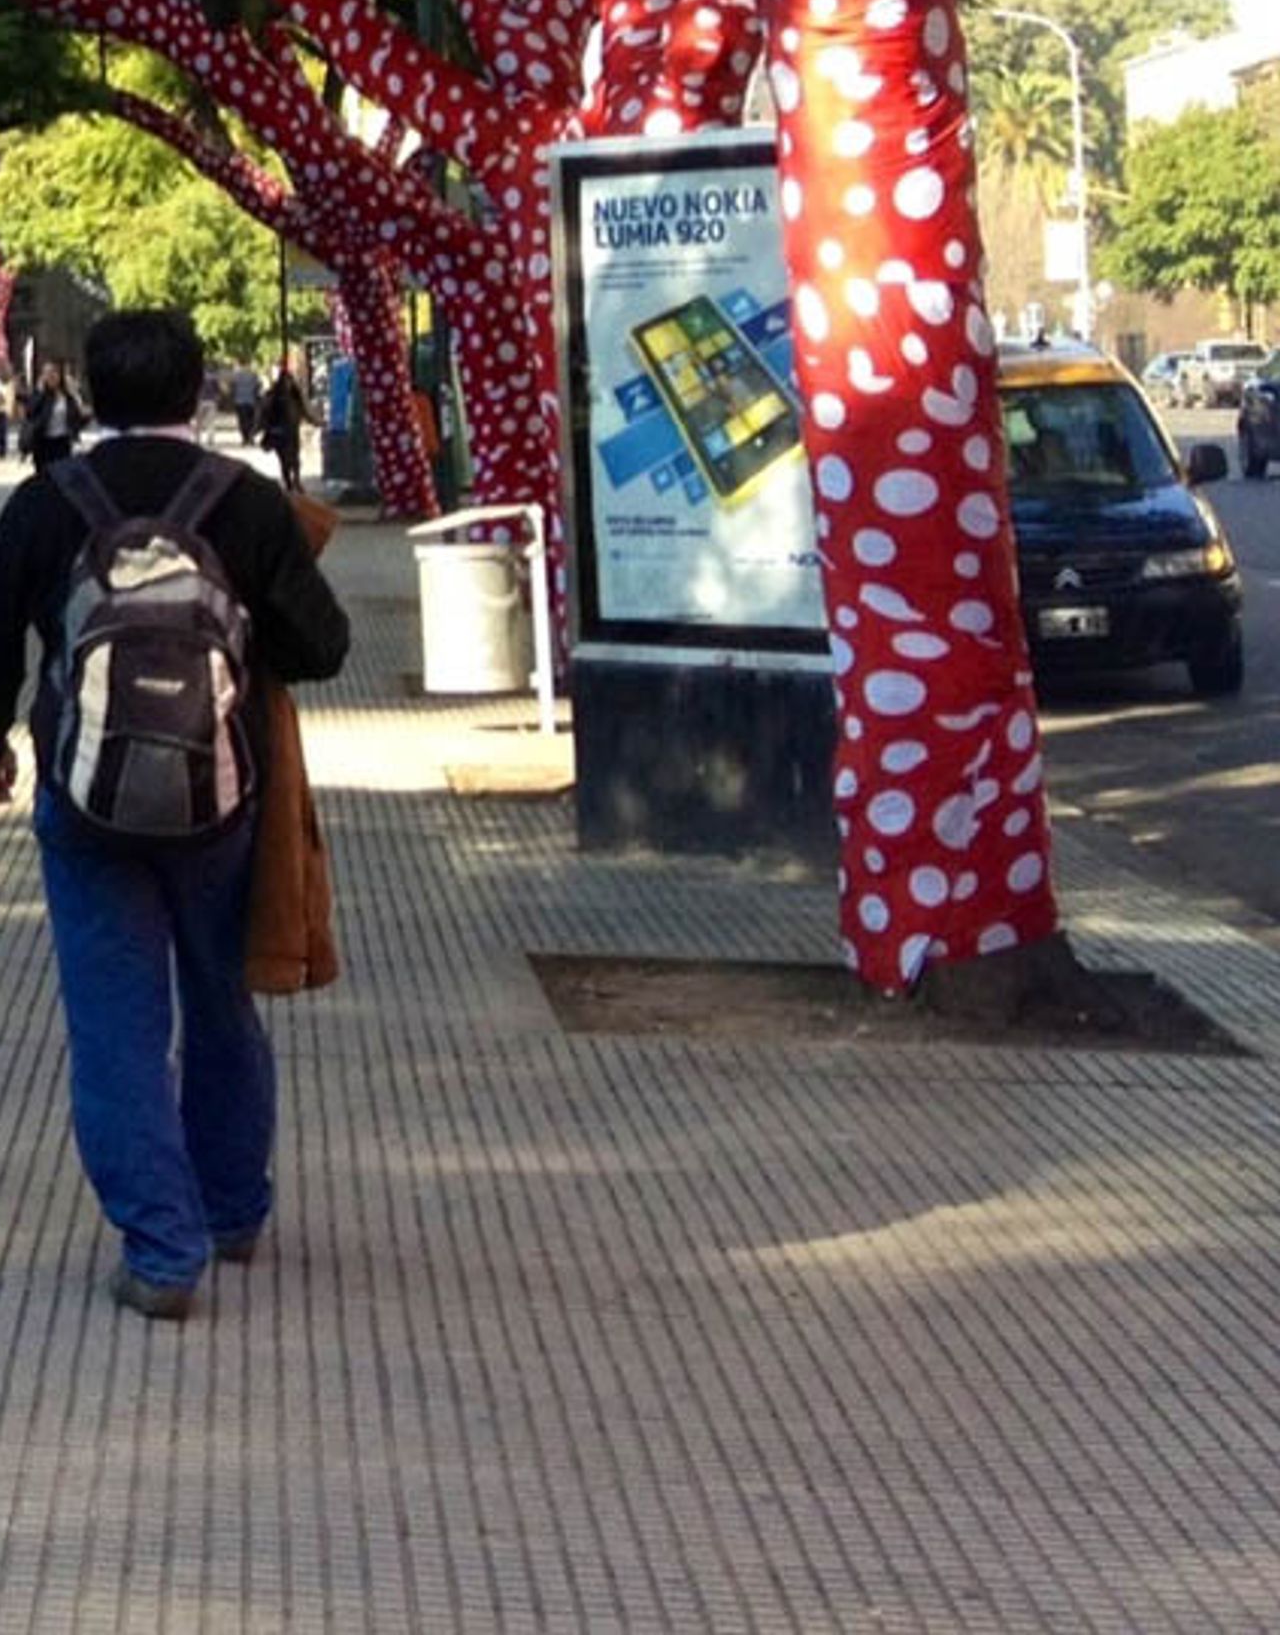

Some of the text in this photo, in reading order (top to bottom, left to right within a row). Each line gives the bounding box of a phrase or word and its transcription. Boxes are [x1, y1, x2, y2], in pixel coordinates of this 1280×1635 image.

[594, 189, 768, 222] NUEVO NOKIA
[595, 218, 725, 248] LUMIA 920
